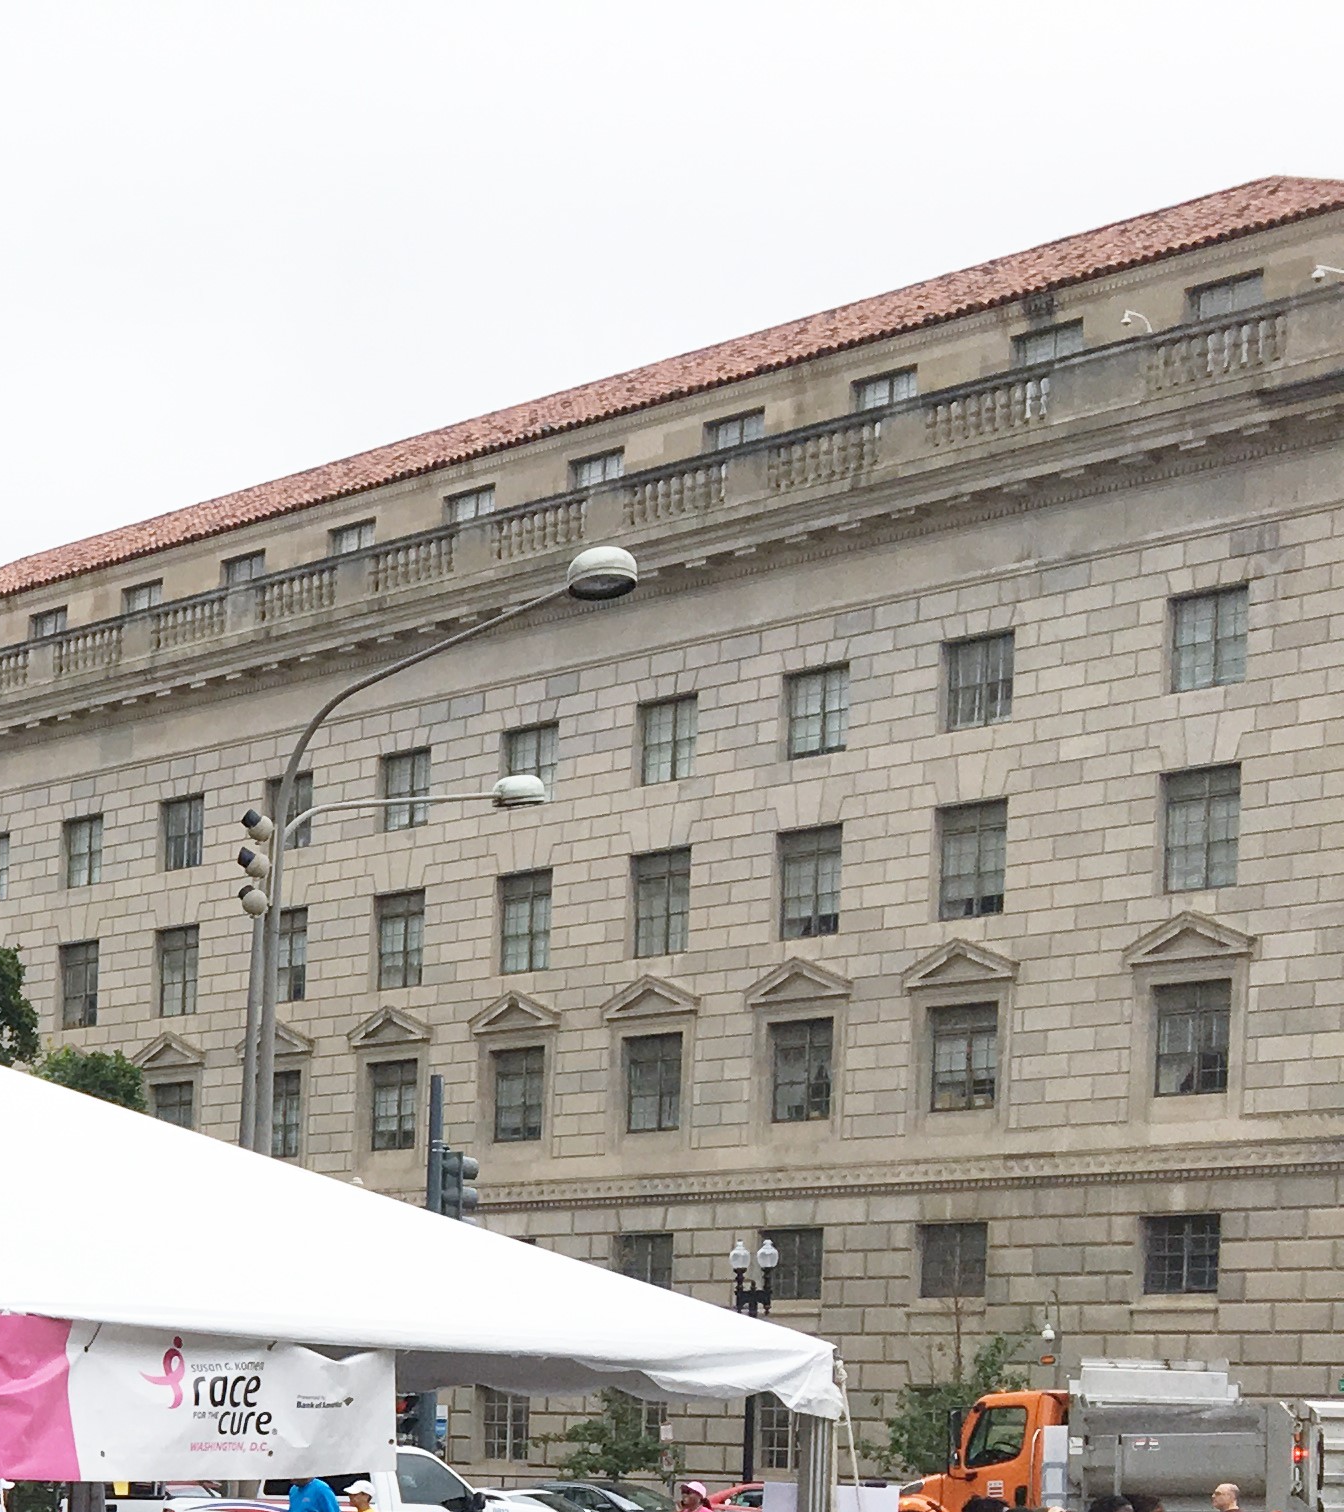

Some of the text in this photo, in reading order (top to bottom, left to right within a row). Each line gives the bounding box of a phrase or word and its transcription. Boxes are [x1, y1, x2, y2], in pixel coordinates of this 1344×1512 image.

[193, 1375, 261, 1408] race
[193, 1411, 206, 1419] FOR
[208, 1411, 219, 1419] THE
